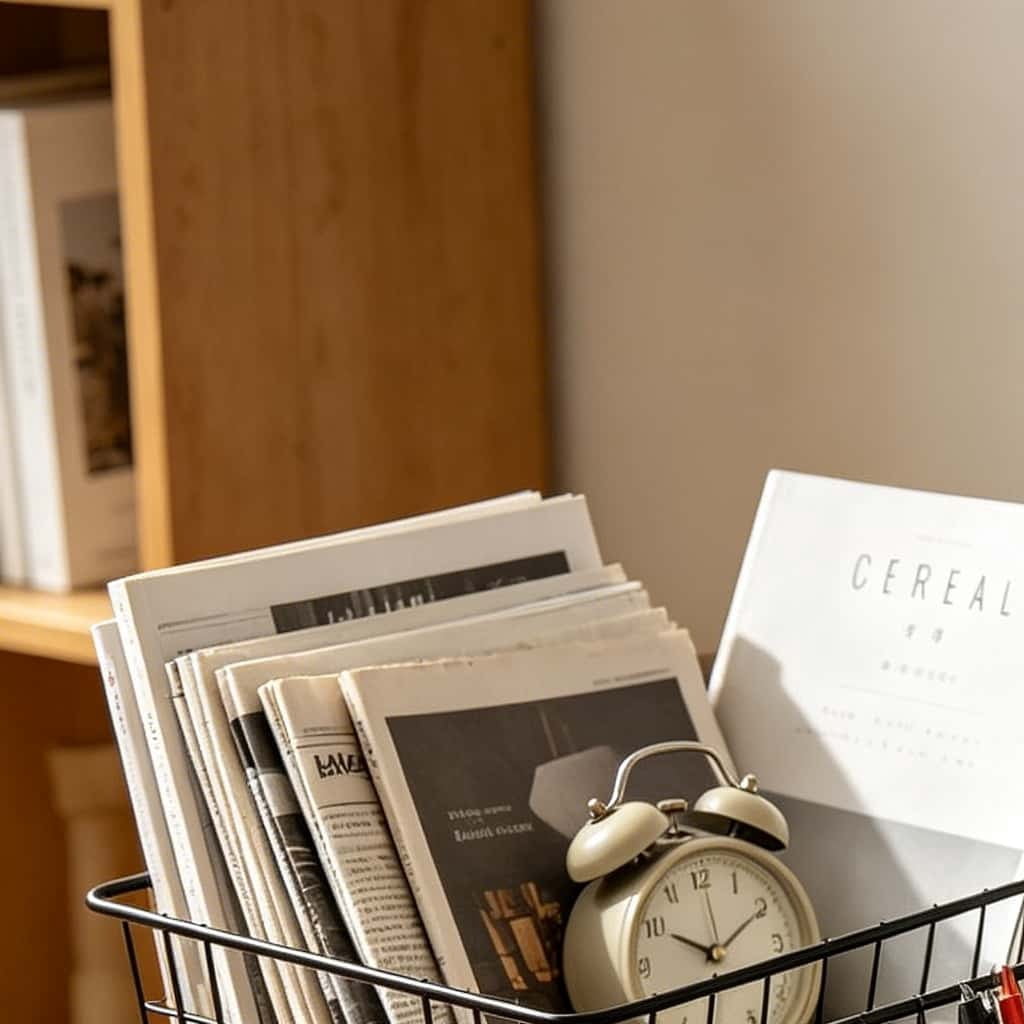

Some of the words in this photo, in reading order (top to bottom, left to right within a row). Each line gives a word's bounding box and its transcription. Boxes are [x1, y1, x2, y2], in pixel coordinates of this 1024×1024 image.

[851, 553, 1011, 617] CEREAL
[690, 868, 711, 891] 12
[731, 871, 738, 895] 1
[664, 883, 679, 904] 11
[753, 897, 768, 920] 2
